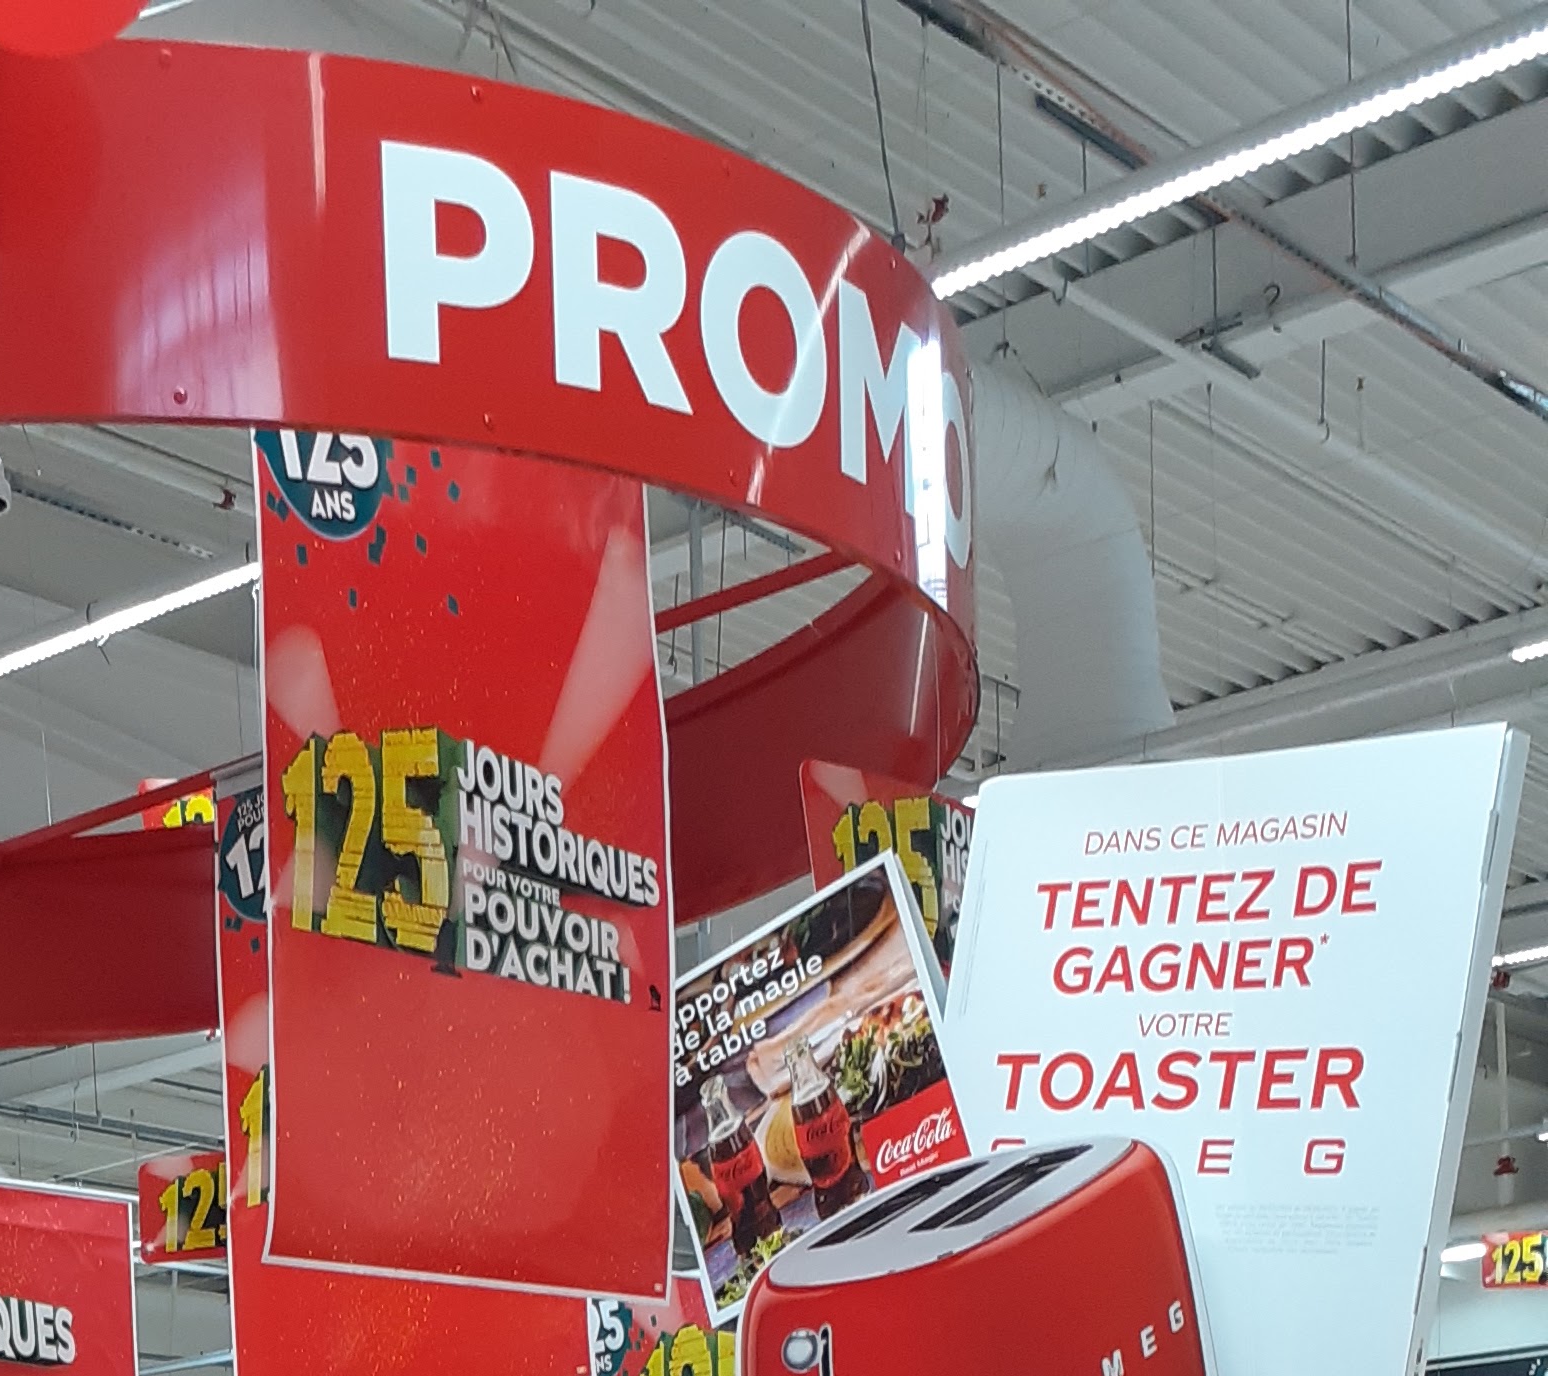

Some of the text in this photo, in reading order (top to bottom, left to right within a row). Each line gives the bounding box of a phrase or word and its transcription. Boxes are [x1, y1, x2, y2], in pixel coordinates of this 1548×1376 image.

[381, 139, 972, 571] PROMO
[311, 489, 357, 522] ANS
[457, 739, 564, 826] JOURS
[282, 725, 450, 953] 125
[457, 788, 660, 907] HISTORIQUES
[1084, 810, 1349, 858] DANS CE MAGASIN
[463, 859, 560, 906] POUR VOTRE
[1036, 859, 1384, 932] TENTEZ DE
[464, 884, 620, 960] POUVOIR
[705, 1011, 733, 1039] la
[733, 953, 824, 1017] magie
[1136, 1011, 1234, 1039] VOTRE
[675, 1017, 768, 1087] à table
[995, 1046, 1366, 1113] TOASTER
[1492, 1233, 1544, 1285] 125
